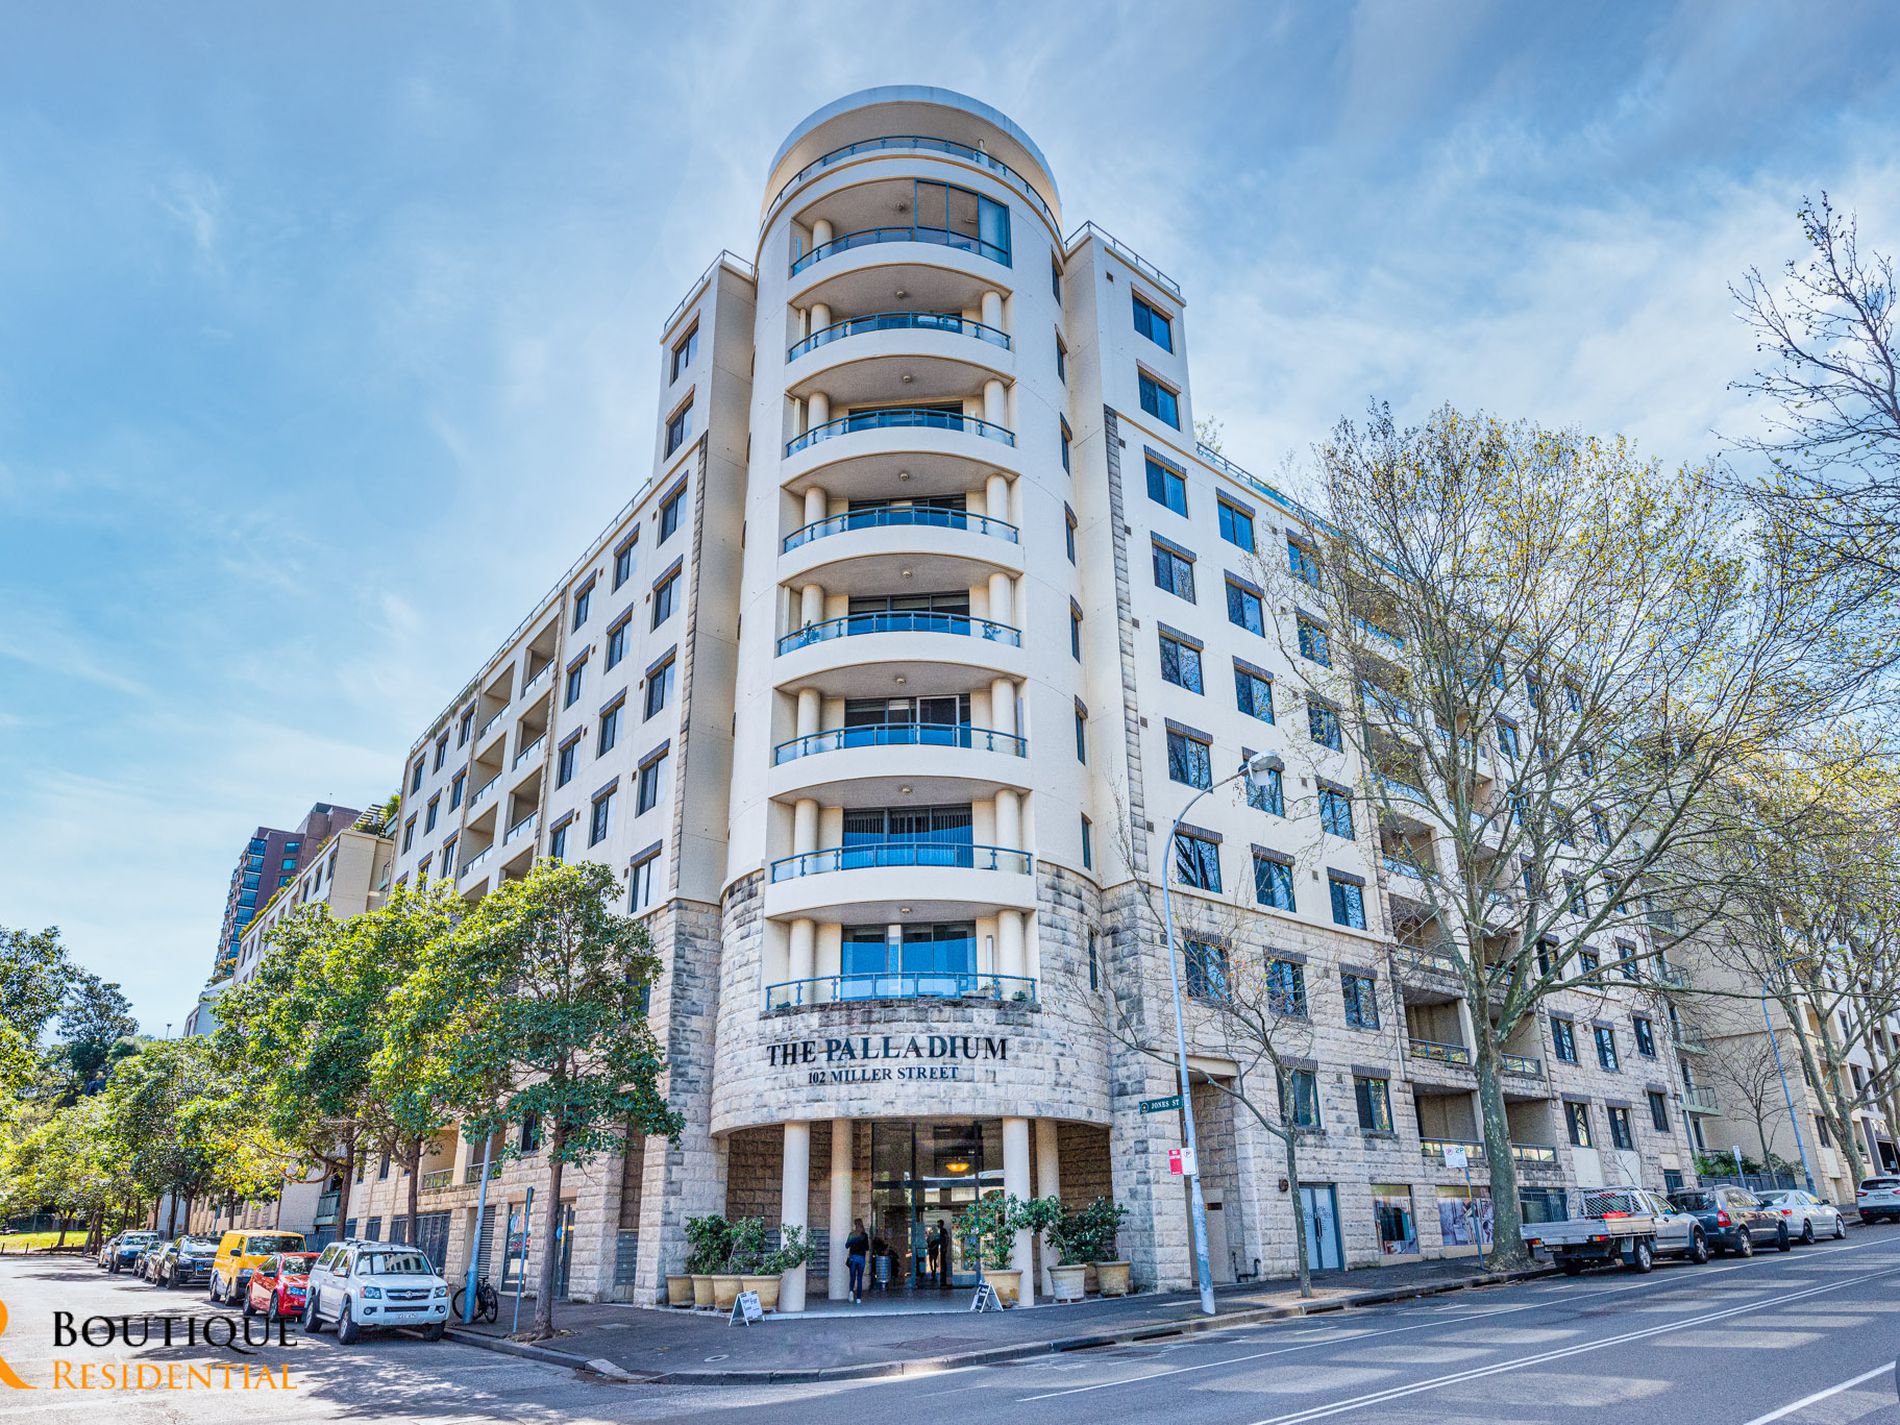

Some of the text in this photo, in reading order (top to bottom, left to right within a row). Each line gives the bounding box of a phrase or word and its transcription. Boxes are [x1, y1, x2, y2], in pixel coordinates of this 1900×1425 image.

[767, 1034, 1009, 1067] THE PALLADIUM
[808, 1066, 959, 1084] 102 MILLER STREET
[1151, 1099, 1180, 1110] JONES ST
